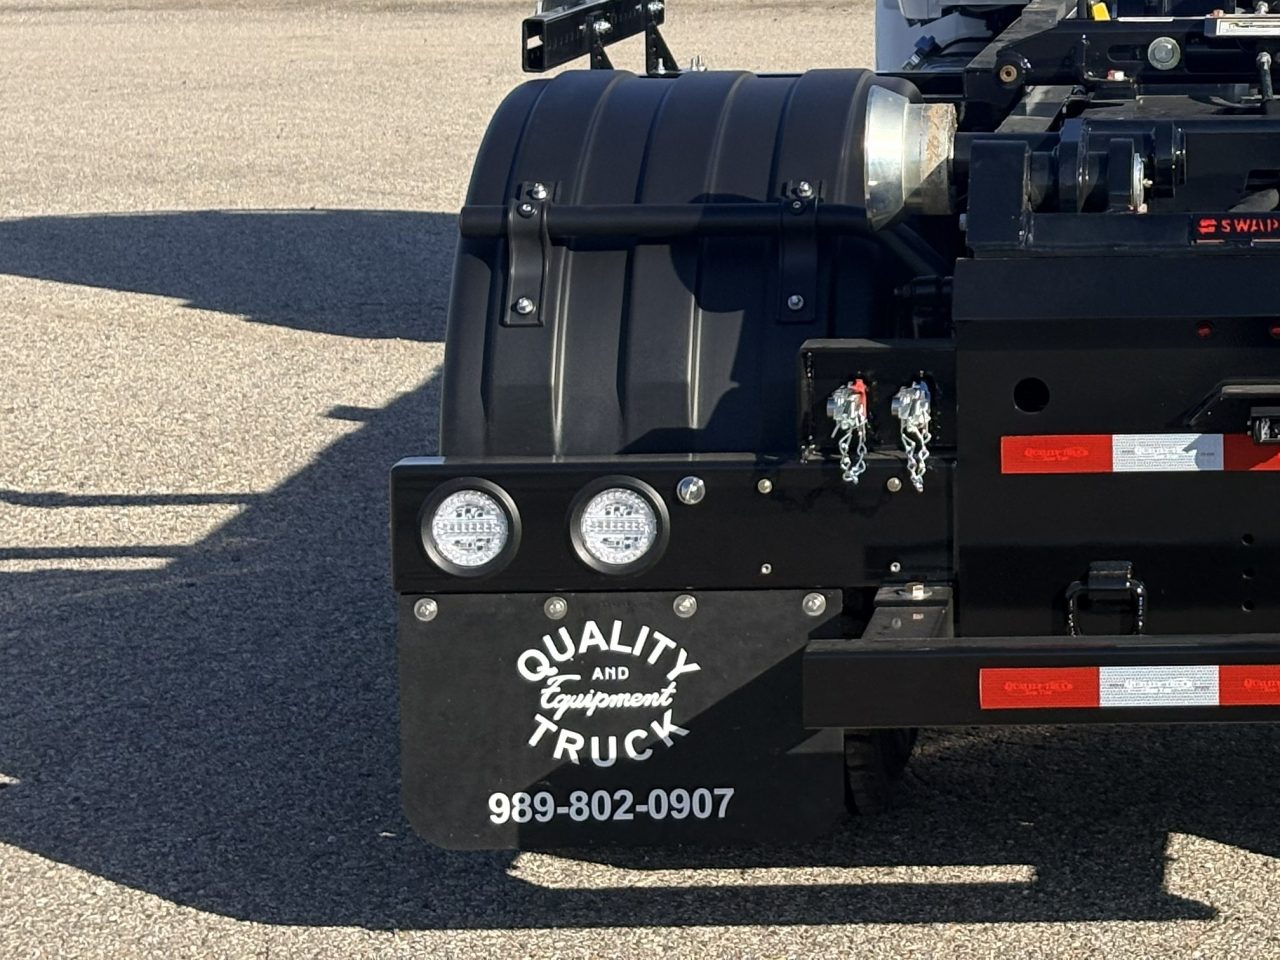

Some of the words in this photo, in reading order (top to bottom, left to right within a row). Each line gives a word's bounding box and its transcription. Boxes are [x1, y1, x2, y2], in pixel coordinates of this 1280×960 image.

[516, 619, 702, 682] QUALITY
[591, 666, 630, 681] AND
[540, 674, 677, 721] Equipment
[528, 708, 691, 768] TRUCK
[488, 787, 735, 825] 989-802-0907
